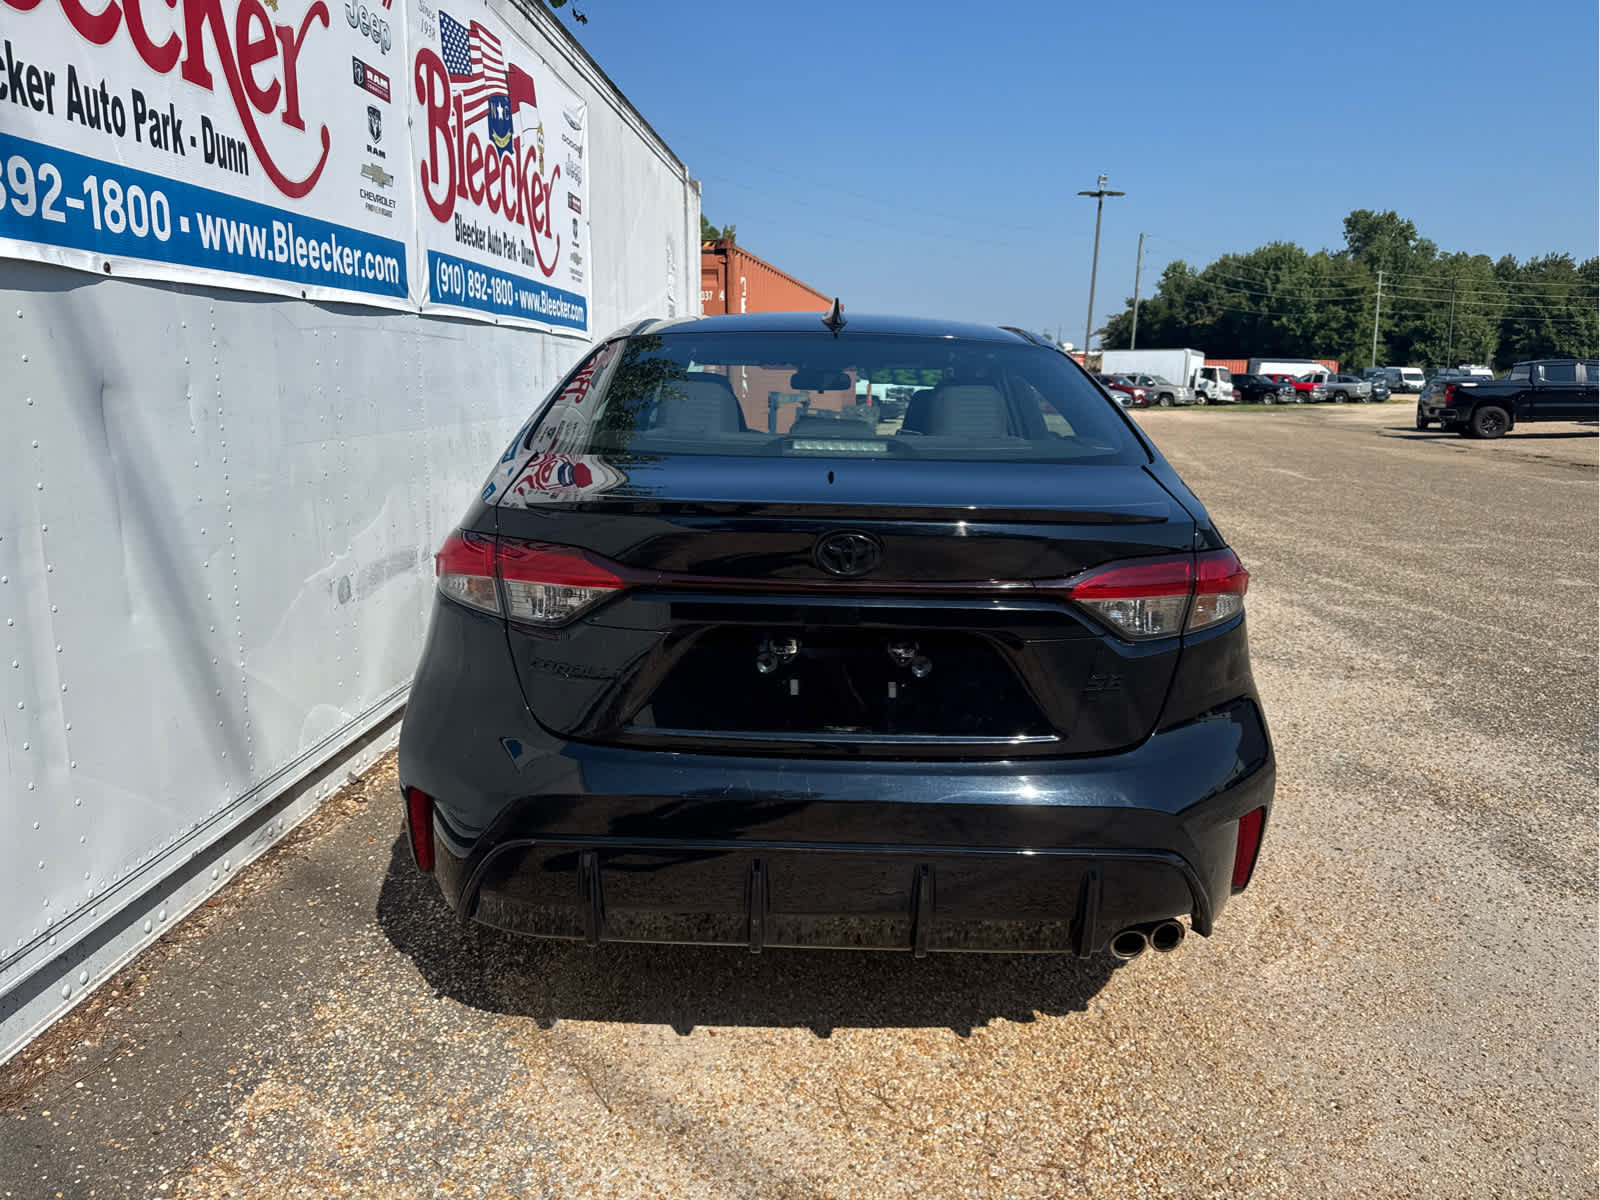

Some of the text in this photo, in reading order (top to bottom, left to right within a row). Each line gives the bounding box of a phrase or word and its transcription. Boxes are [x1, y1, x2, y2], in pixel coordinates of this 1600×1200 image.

[345, 0, 391, 55] Jeep
[366, 69, 389, 90] RAM
[67, 64, 126, 137] Auto
[132, 88, 185, 156] Park
[201, 115, 249, 176] Dunn
[366, 144, 386, 159] RAM
[414, 48, 561, 277] Bleecker
[0, 155, 399, 285] 92-1800 www.Bleecker.com
[360, 188, 396, 208] CHEVROLET
[454, 212, 535, 268] Bleecker Auto Park Dunn
[436, 257, 585, 323] (910) 892-1800 www.Bleecker.com
